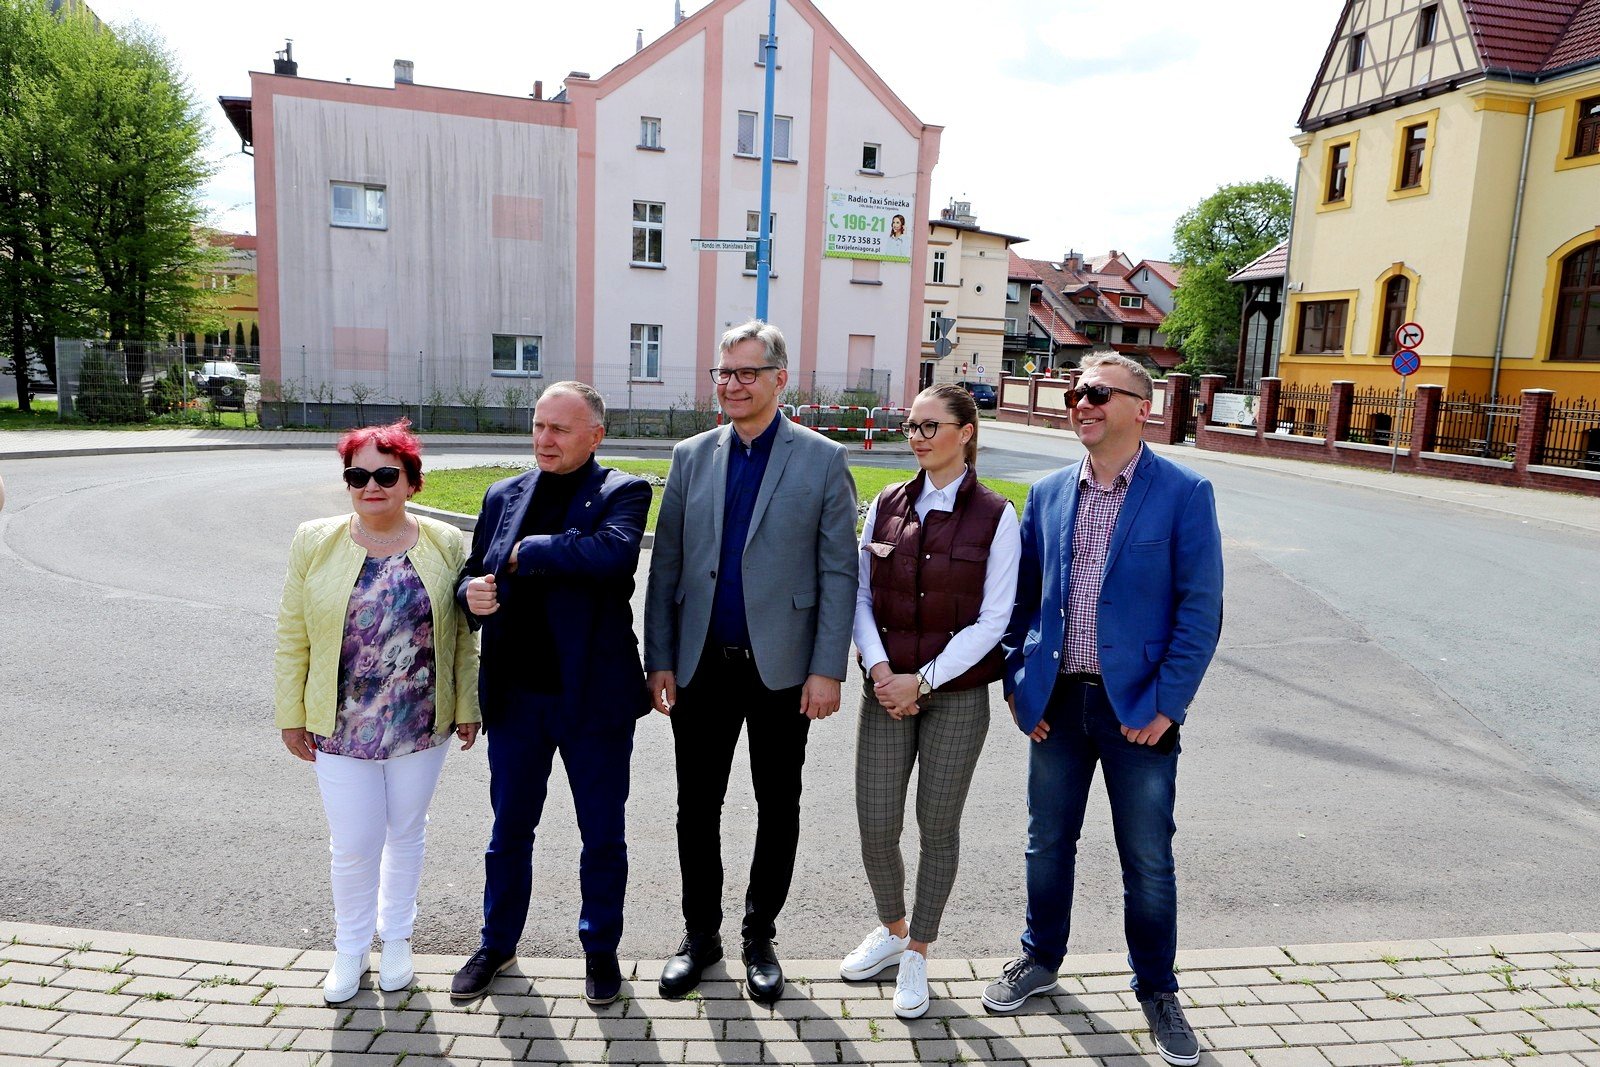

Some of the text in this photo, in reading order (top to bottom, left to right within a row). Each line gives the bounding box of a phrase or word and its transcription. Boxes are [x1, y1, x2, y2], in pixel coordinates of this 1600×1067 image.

[848, 194, 868, 204] Radio
[869, 196, 883, 205] Taxi
[884, 197, 910, 208] Śnieżka
[842, 213, 886, 232] 196-21
[837, 234, 881, 245] 75 75 358 35
[722, 242, 743, 250] Stanisława
[835, 244, 881, 253] taxijeleniagora.pl
